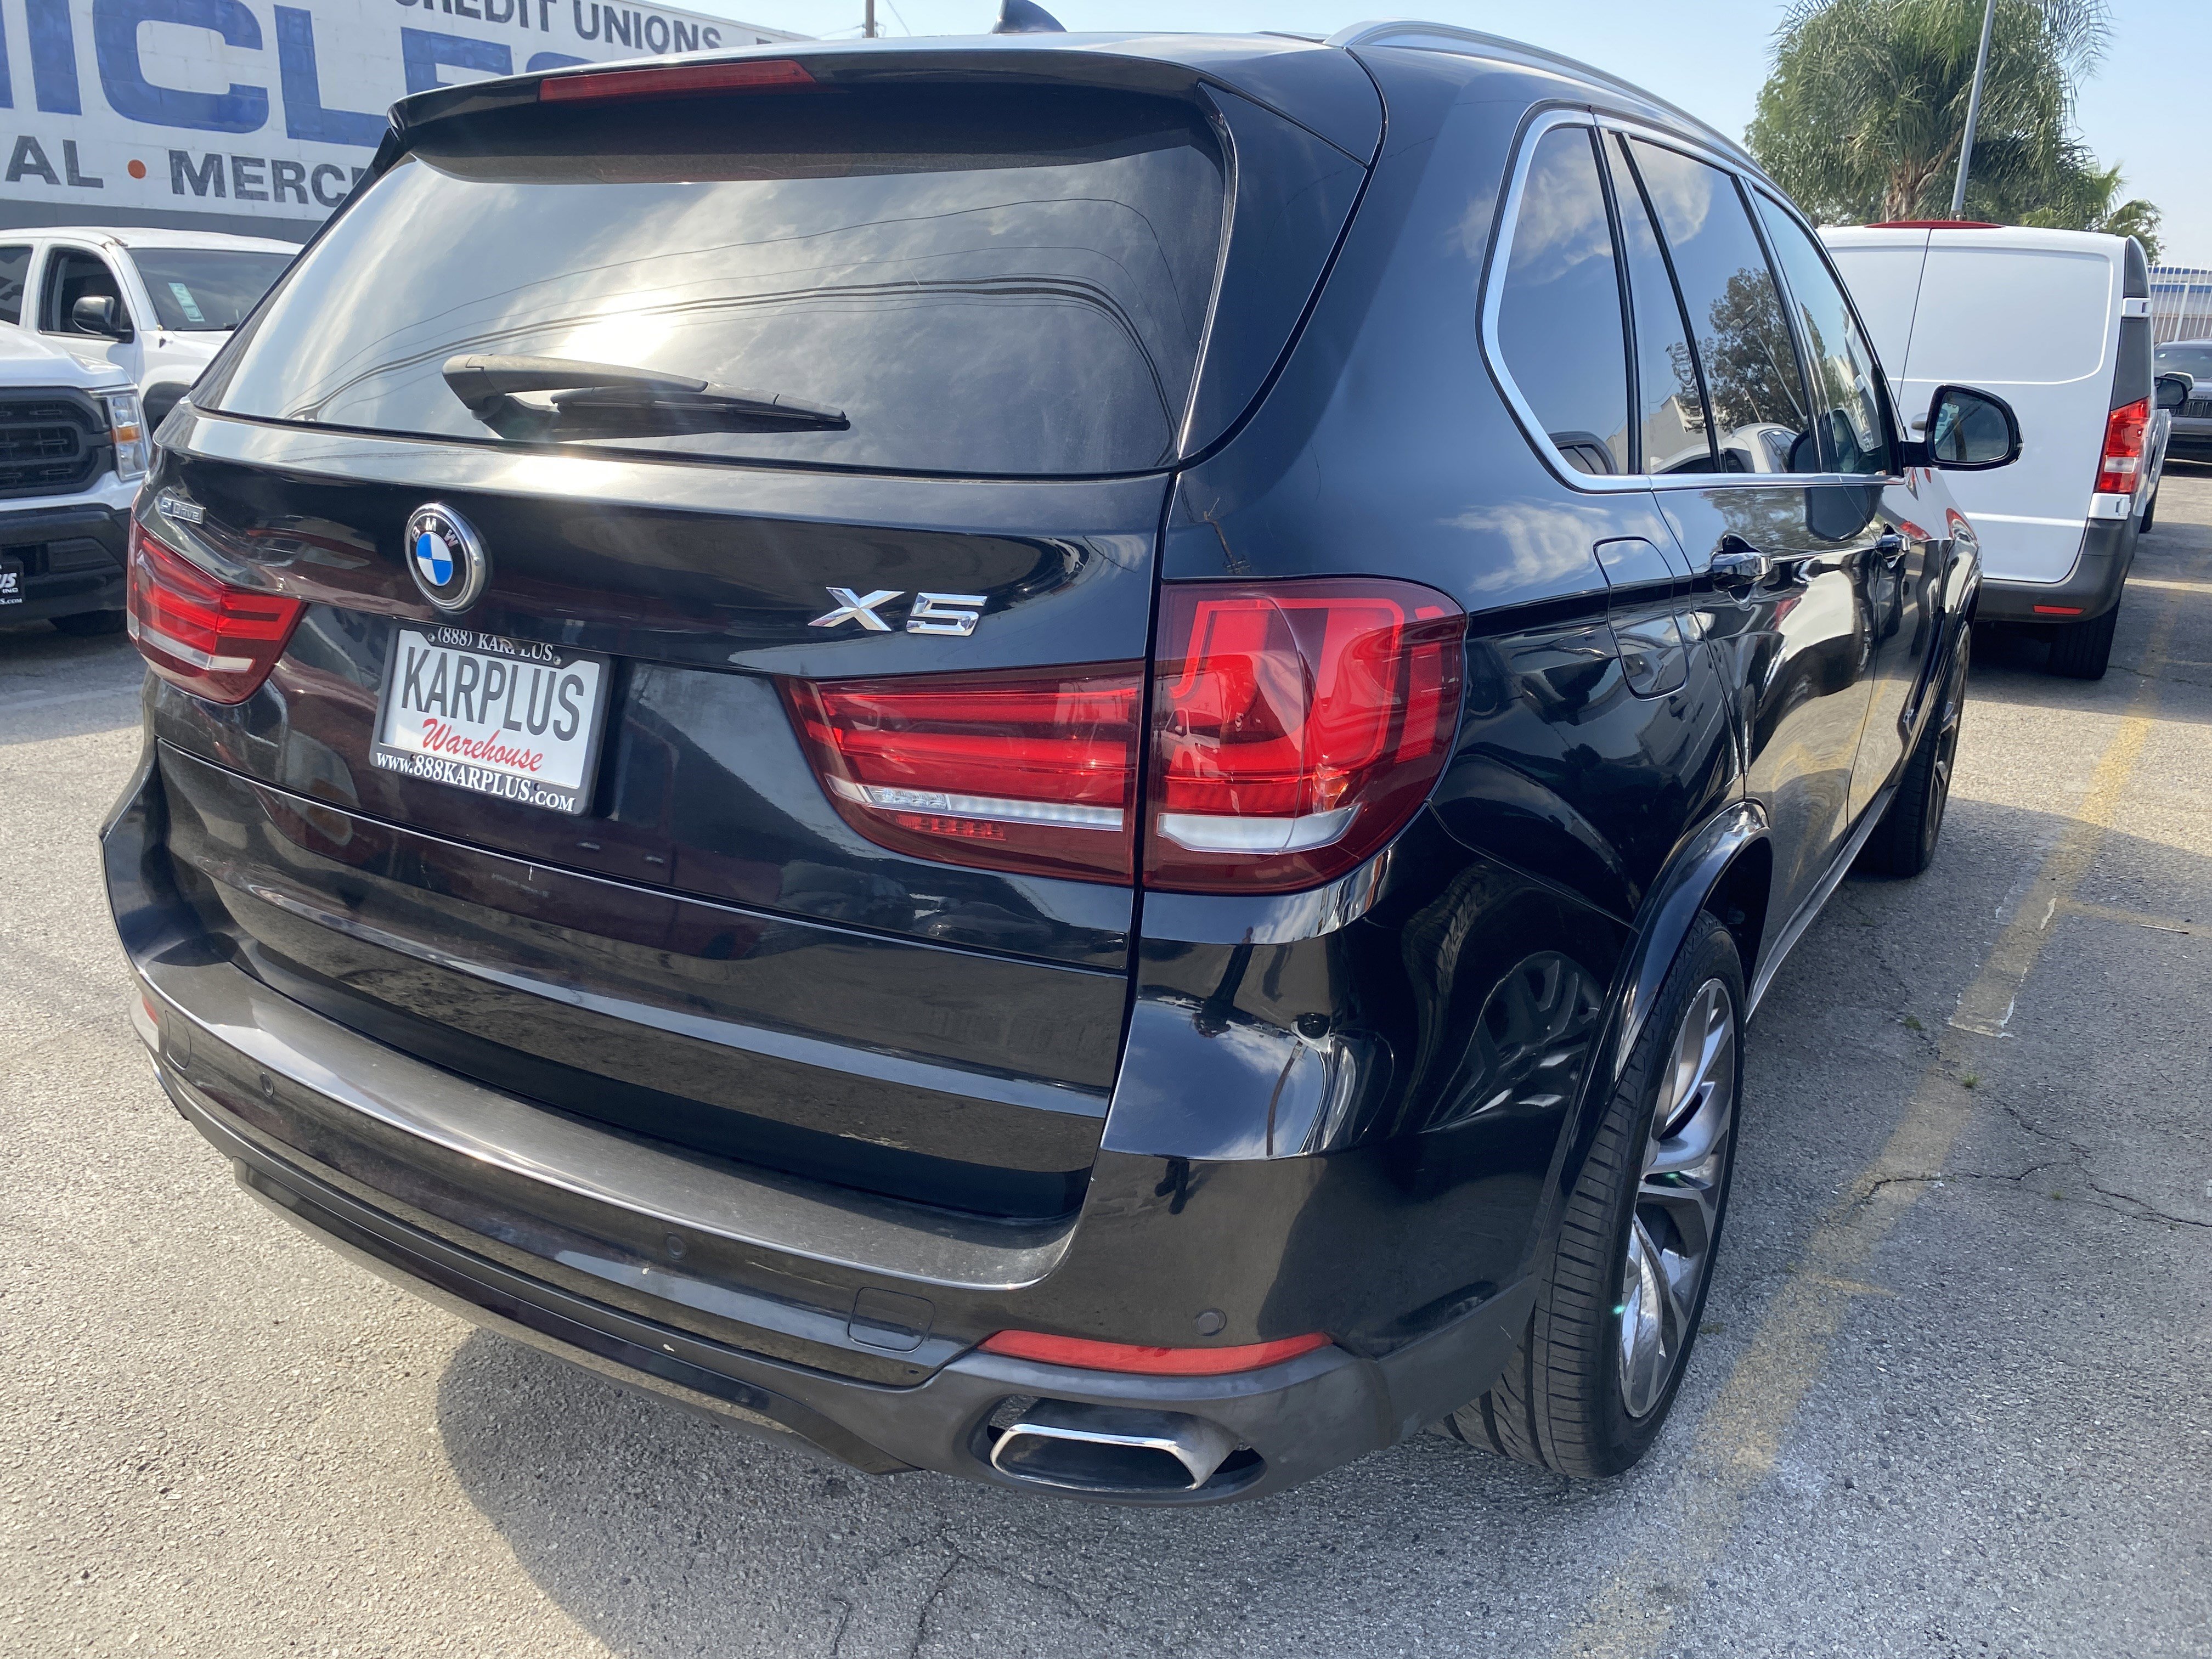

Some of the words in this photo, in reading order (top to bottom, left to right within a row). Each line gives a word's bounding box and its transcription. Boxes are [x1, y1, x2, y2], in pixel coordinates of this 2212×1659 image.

[573, 0, 722, 54] UNIONS
[168, 149, 366, 207] MERC
[411, 517, 459, 548] BMW
[438, 627, 473, 647] (888)
[807, 586, 988, 636] X5
[400, 646, 585, 742] KARPLUS
[422, 718, 544, 772] Warehouse
